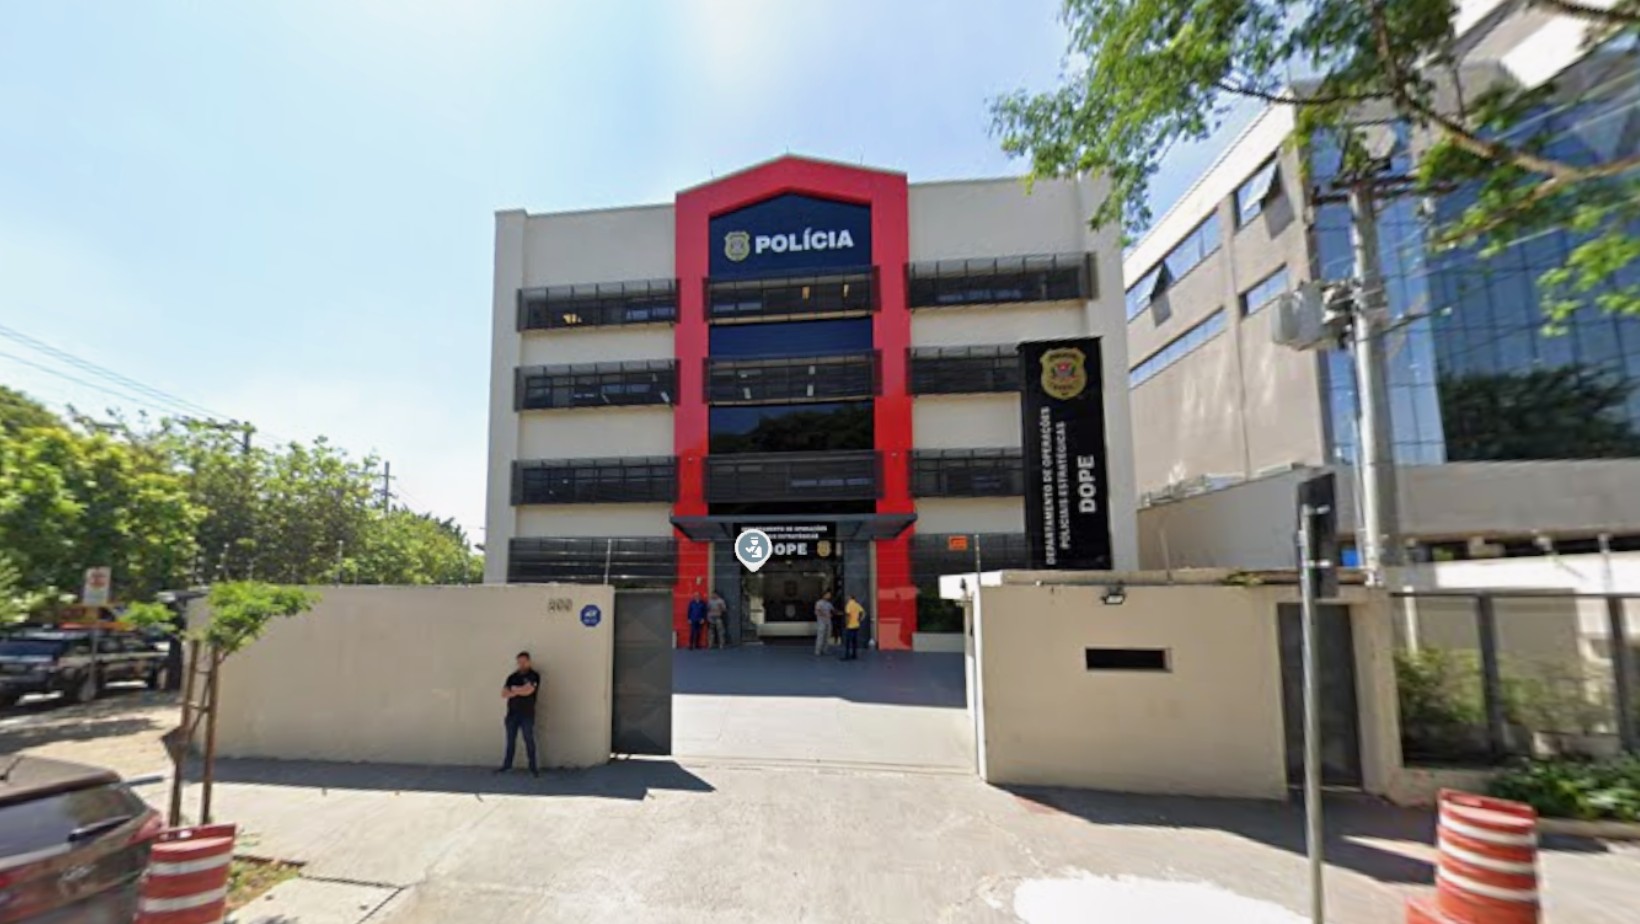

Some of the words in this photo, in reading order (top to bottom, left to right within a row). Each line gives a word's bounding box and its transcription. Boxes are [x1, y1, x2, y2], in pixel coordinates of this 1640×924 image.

[755, 227, 854, 254] POLÍCIA
[1040, 406, 1053, 468] OPERAÇÕES
[1042, 469, 1053, 482] DE
[1077, 455, 1096, 513] DOPE
[772, 542, 808, 556] OPE
[1043, 485, 1056, 565] DEPARTAMENTO
[1059, 499, 1071, 550] POLICIAIS
